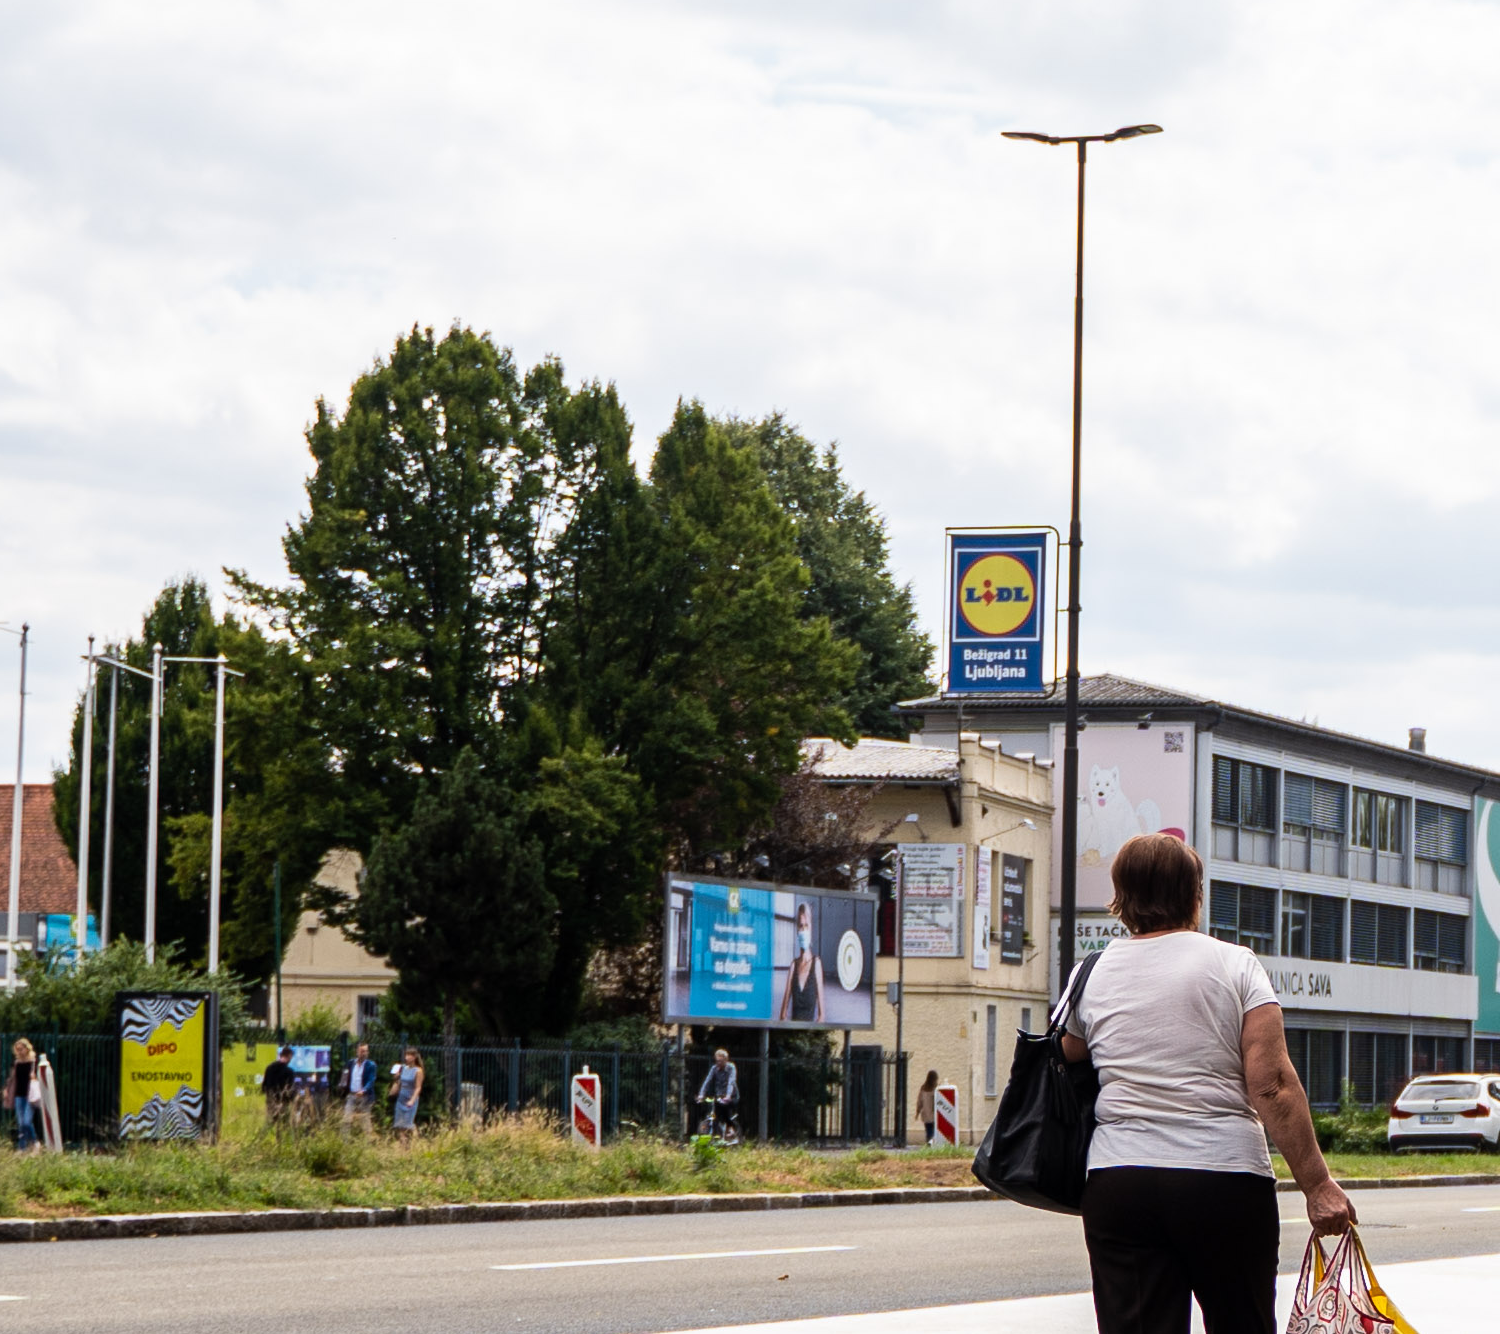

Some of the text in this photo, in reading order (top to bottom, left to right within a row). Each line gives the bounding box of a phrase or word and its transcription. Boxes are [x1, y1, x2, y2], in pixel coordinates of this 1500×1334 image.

[963, 648, 1028, 662] Bežigrad 11
[964, 664, 1026, 681] Ljubljana
[1095, 923, 1134, 937] TAČK
[1308, 972, 1332, 998] SAVA
[147, 1042, 178, 1056] DIPO
[131, 1071, 192, 1083] ENOSTAVNO
